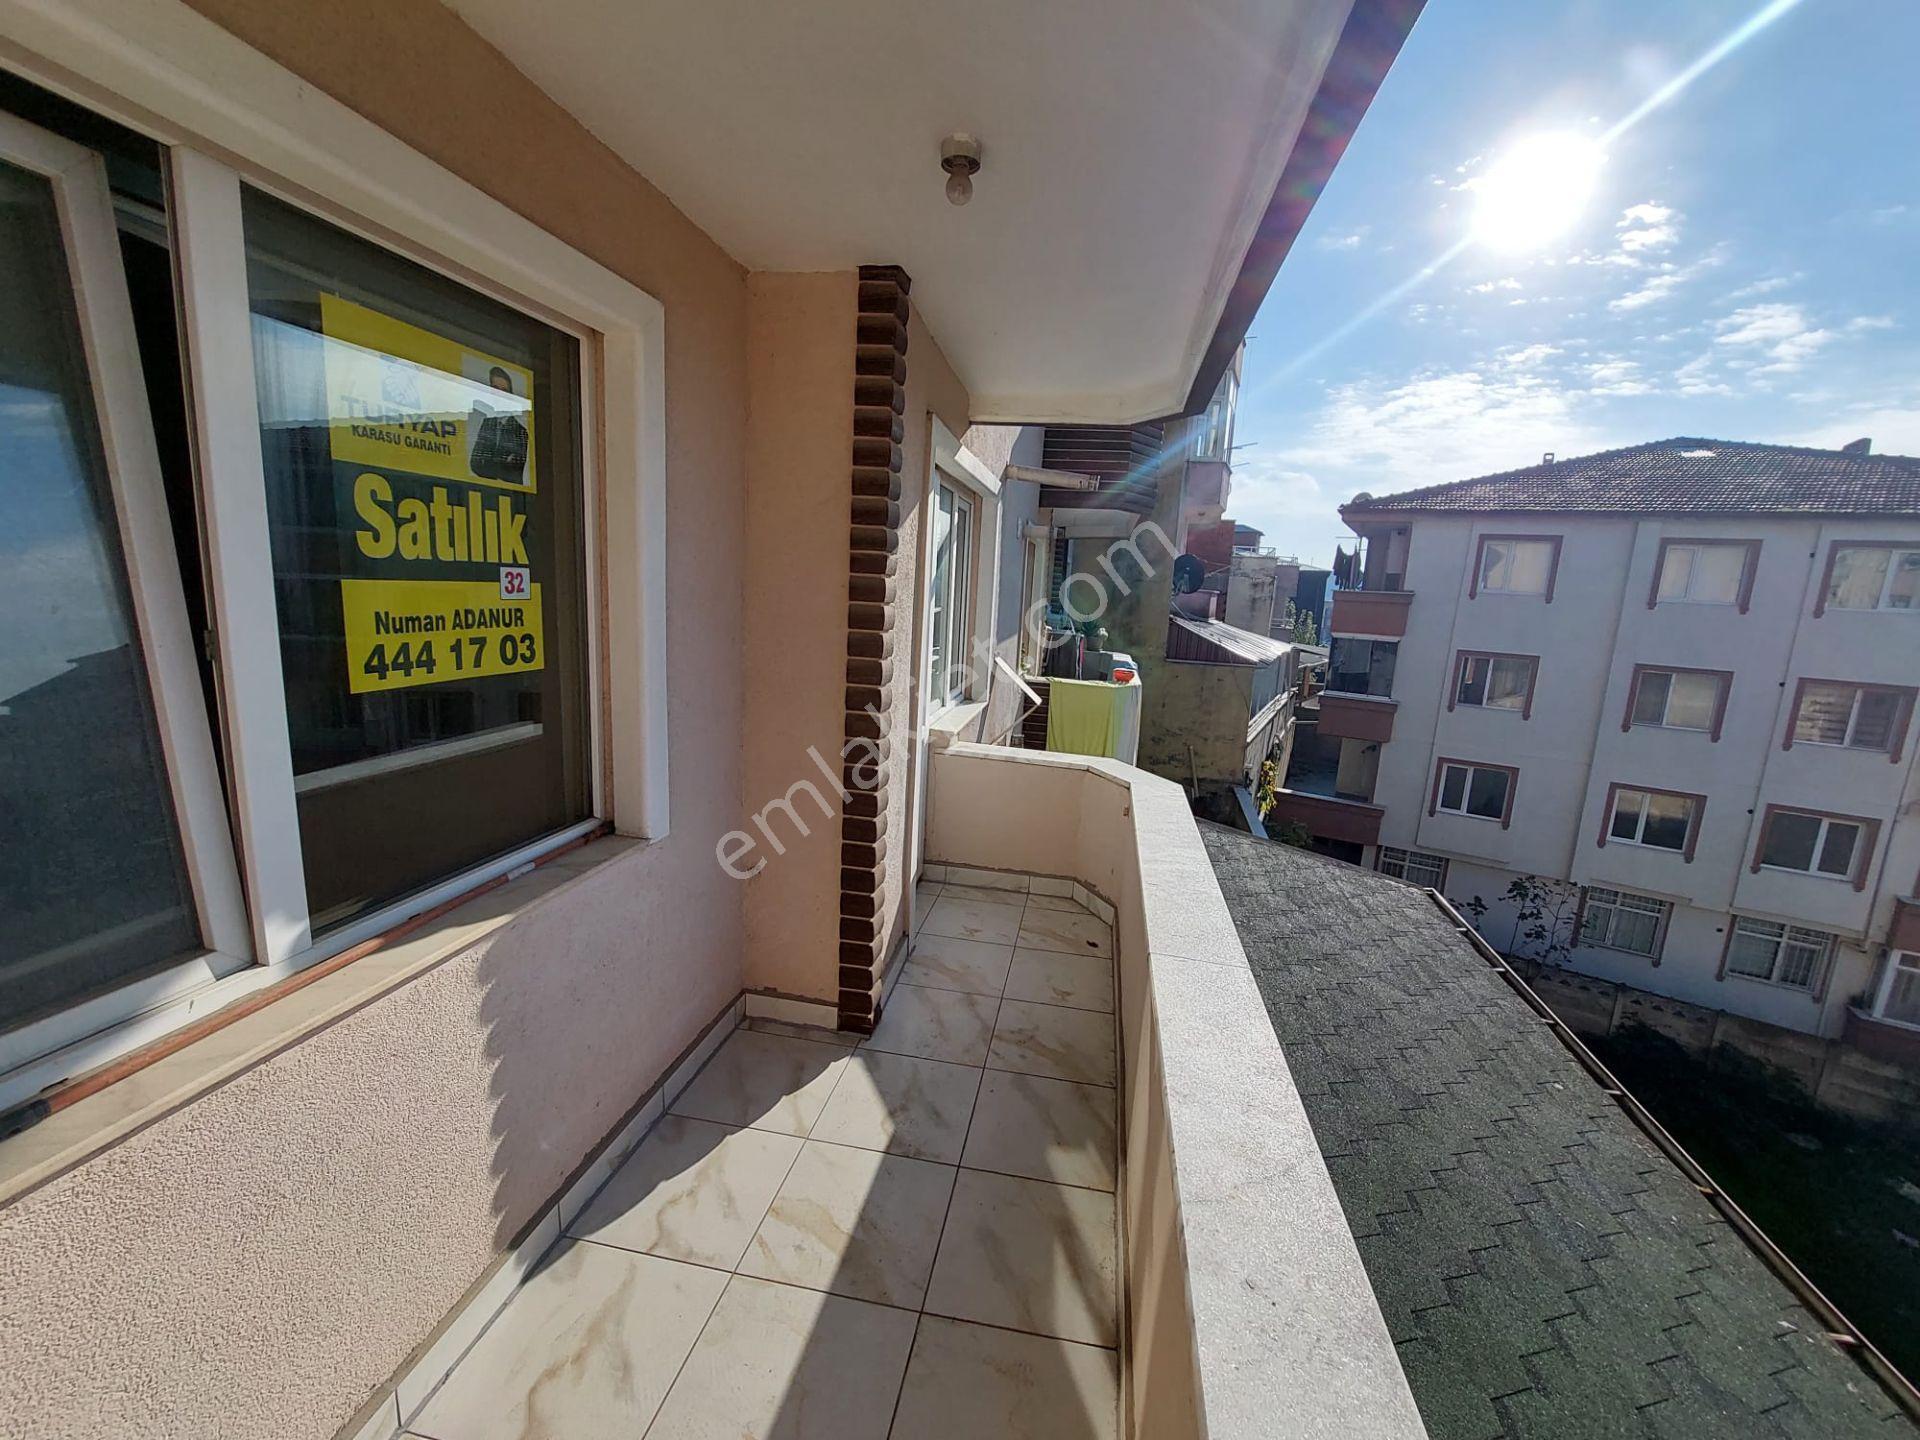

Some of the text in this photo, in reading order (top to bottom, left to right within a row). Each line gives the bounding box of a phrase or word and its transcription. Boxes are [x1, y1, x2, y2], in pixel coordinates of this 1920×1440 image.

[352, 424, 401, 446] KARASU
[353, 472, 530, 565] Satılık
[504, 571, 525, 595] 32
[374, 607, 525, 636] Numan ADANUR
[363, 633, 537, 681] 444 17 03
